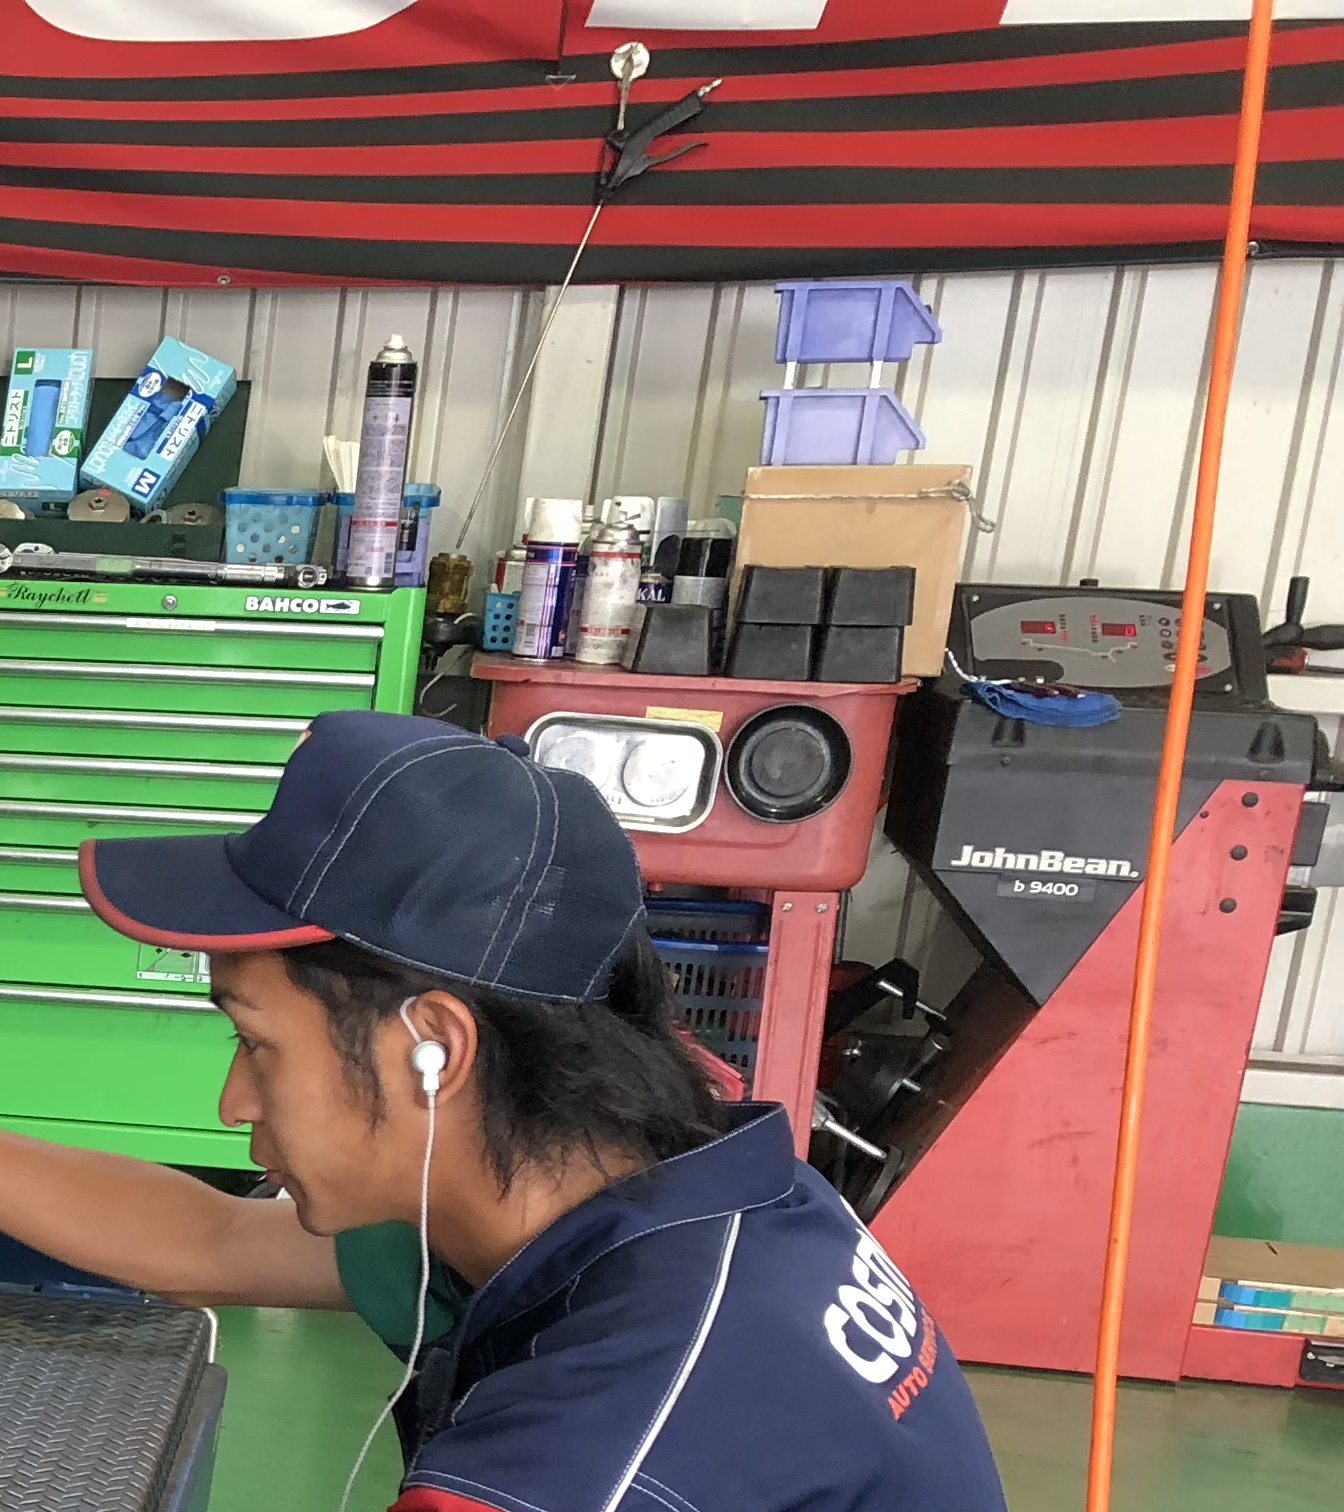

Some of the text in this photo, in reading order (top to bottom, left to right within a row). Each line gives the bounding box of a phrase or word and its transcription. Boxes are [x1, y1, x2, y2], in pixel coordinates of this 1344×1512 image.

[17, 356, 34, 370] L
[4, 391, 23, 446] ニトリスト
[162, 403, 203, 459] ニトリスト
[136, 470, 157, 495] M
[245, 596, 320, 613] BAHCO
[1029, 881, 1079, 896] 9400
[824, 1194, 918, 1384] COSM
[887, 1366, 929, 1422] AUTO
